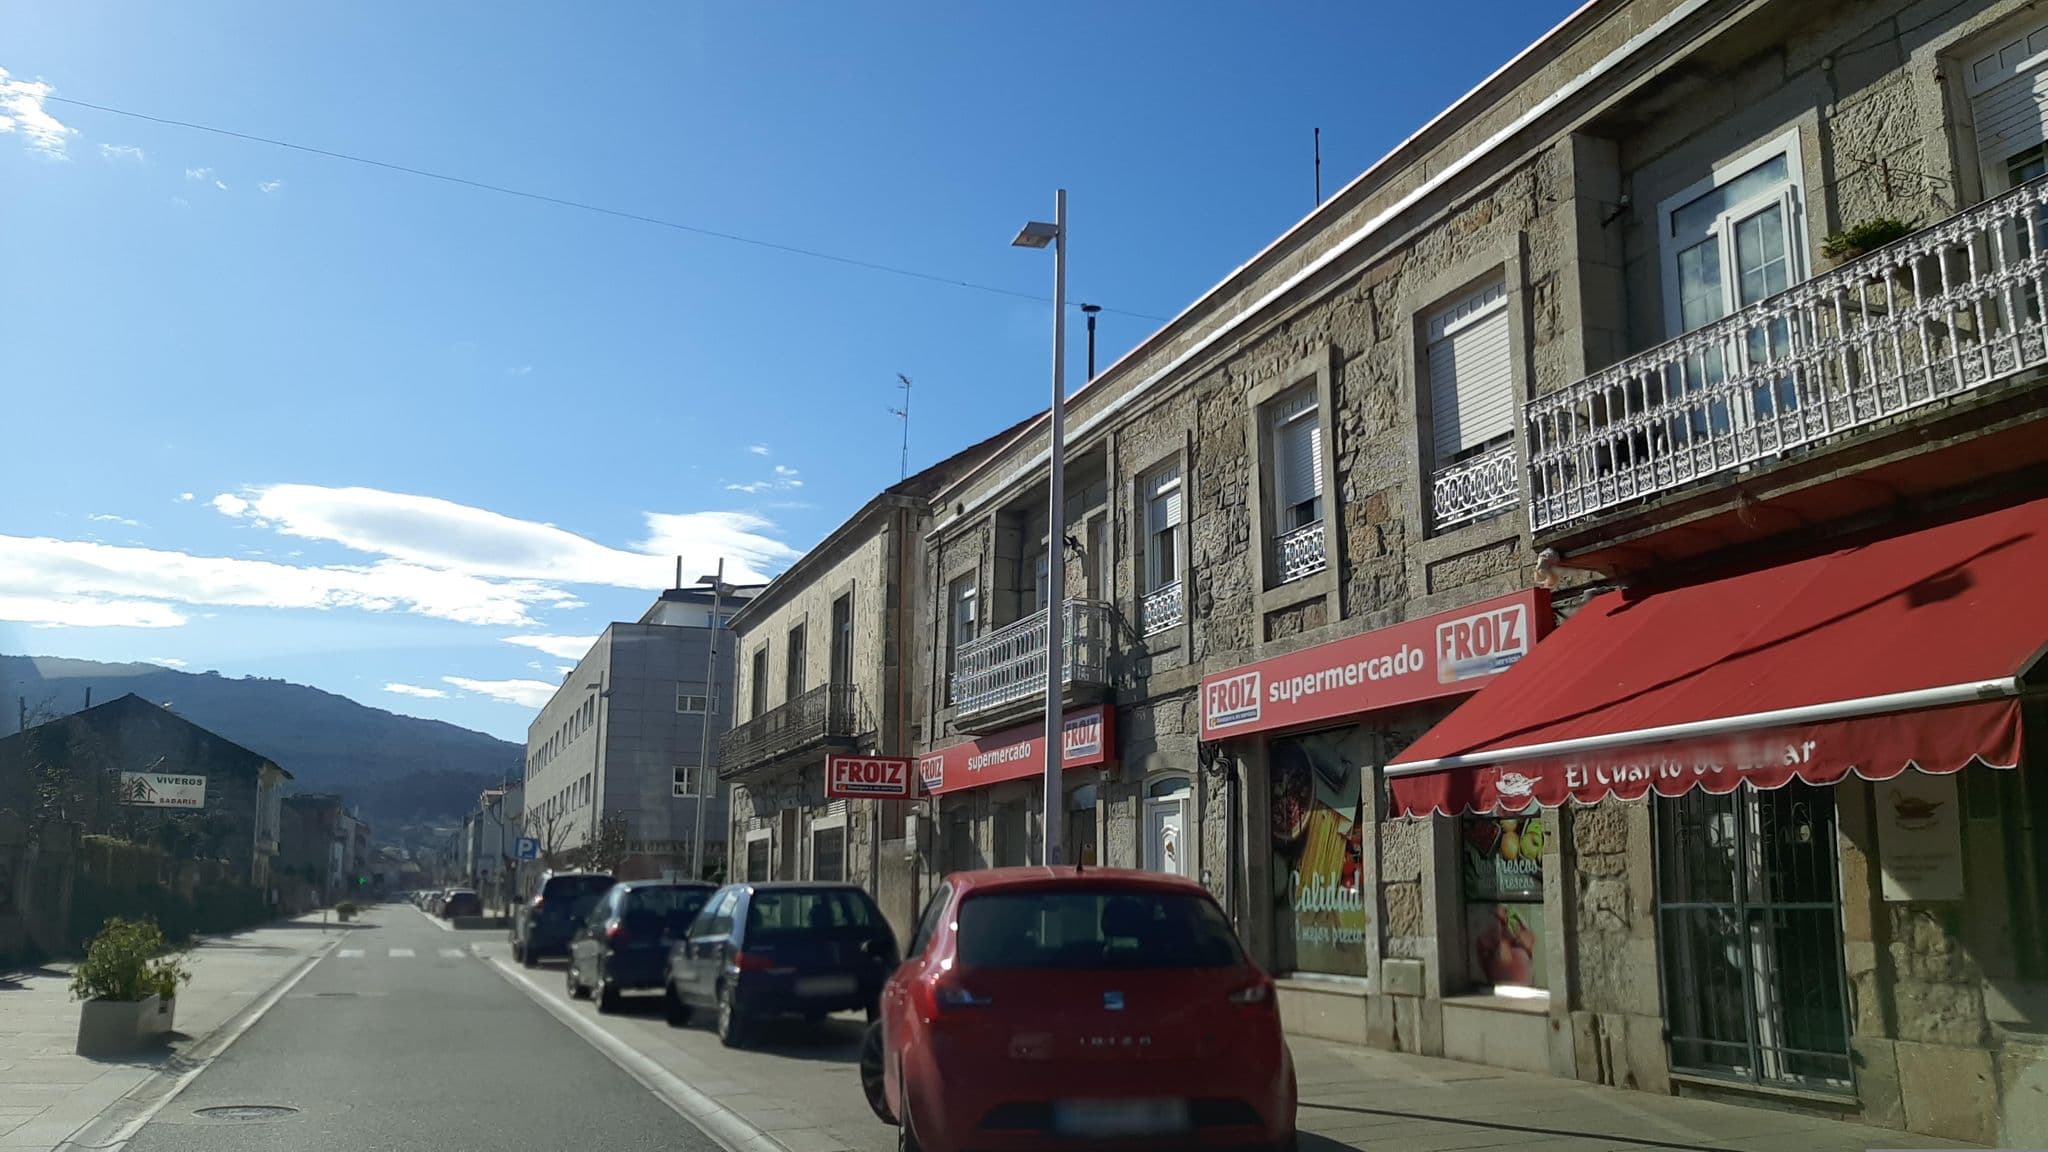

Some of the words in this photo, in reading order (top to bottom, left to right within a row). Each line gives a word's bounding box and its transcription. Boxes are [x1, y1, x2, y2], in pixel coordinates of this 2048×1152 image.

[1440, 609, 1521, 660] FROIZ
[1269, 645, 1424, 703] supermercado
[1209, 675, 1257, 714] FROIZ
[1064, 716, 1097, 747] FROIZ
[922, 759, 942, 780] FROIZ
[968, 742, 1031, 771] supermercado
[157, 777, 202, 786] VIVEROS
[837, 761, 902, 783] FROIZ
[1565, 763, 1588, 787] El
[518, 839, 532, 857] P
[1288, 870, 1362, 912] Calidad
